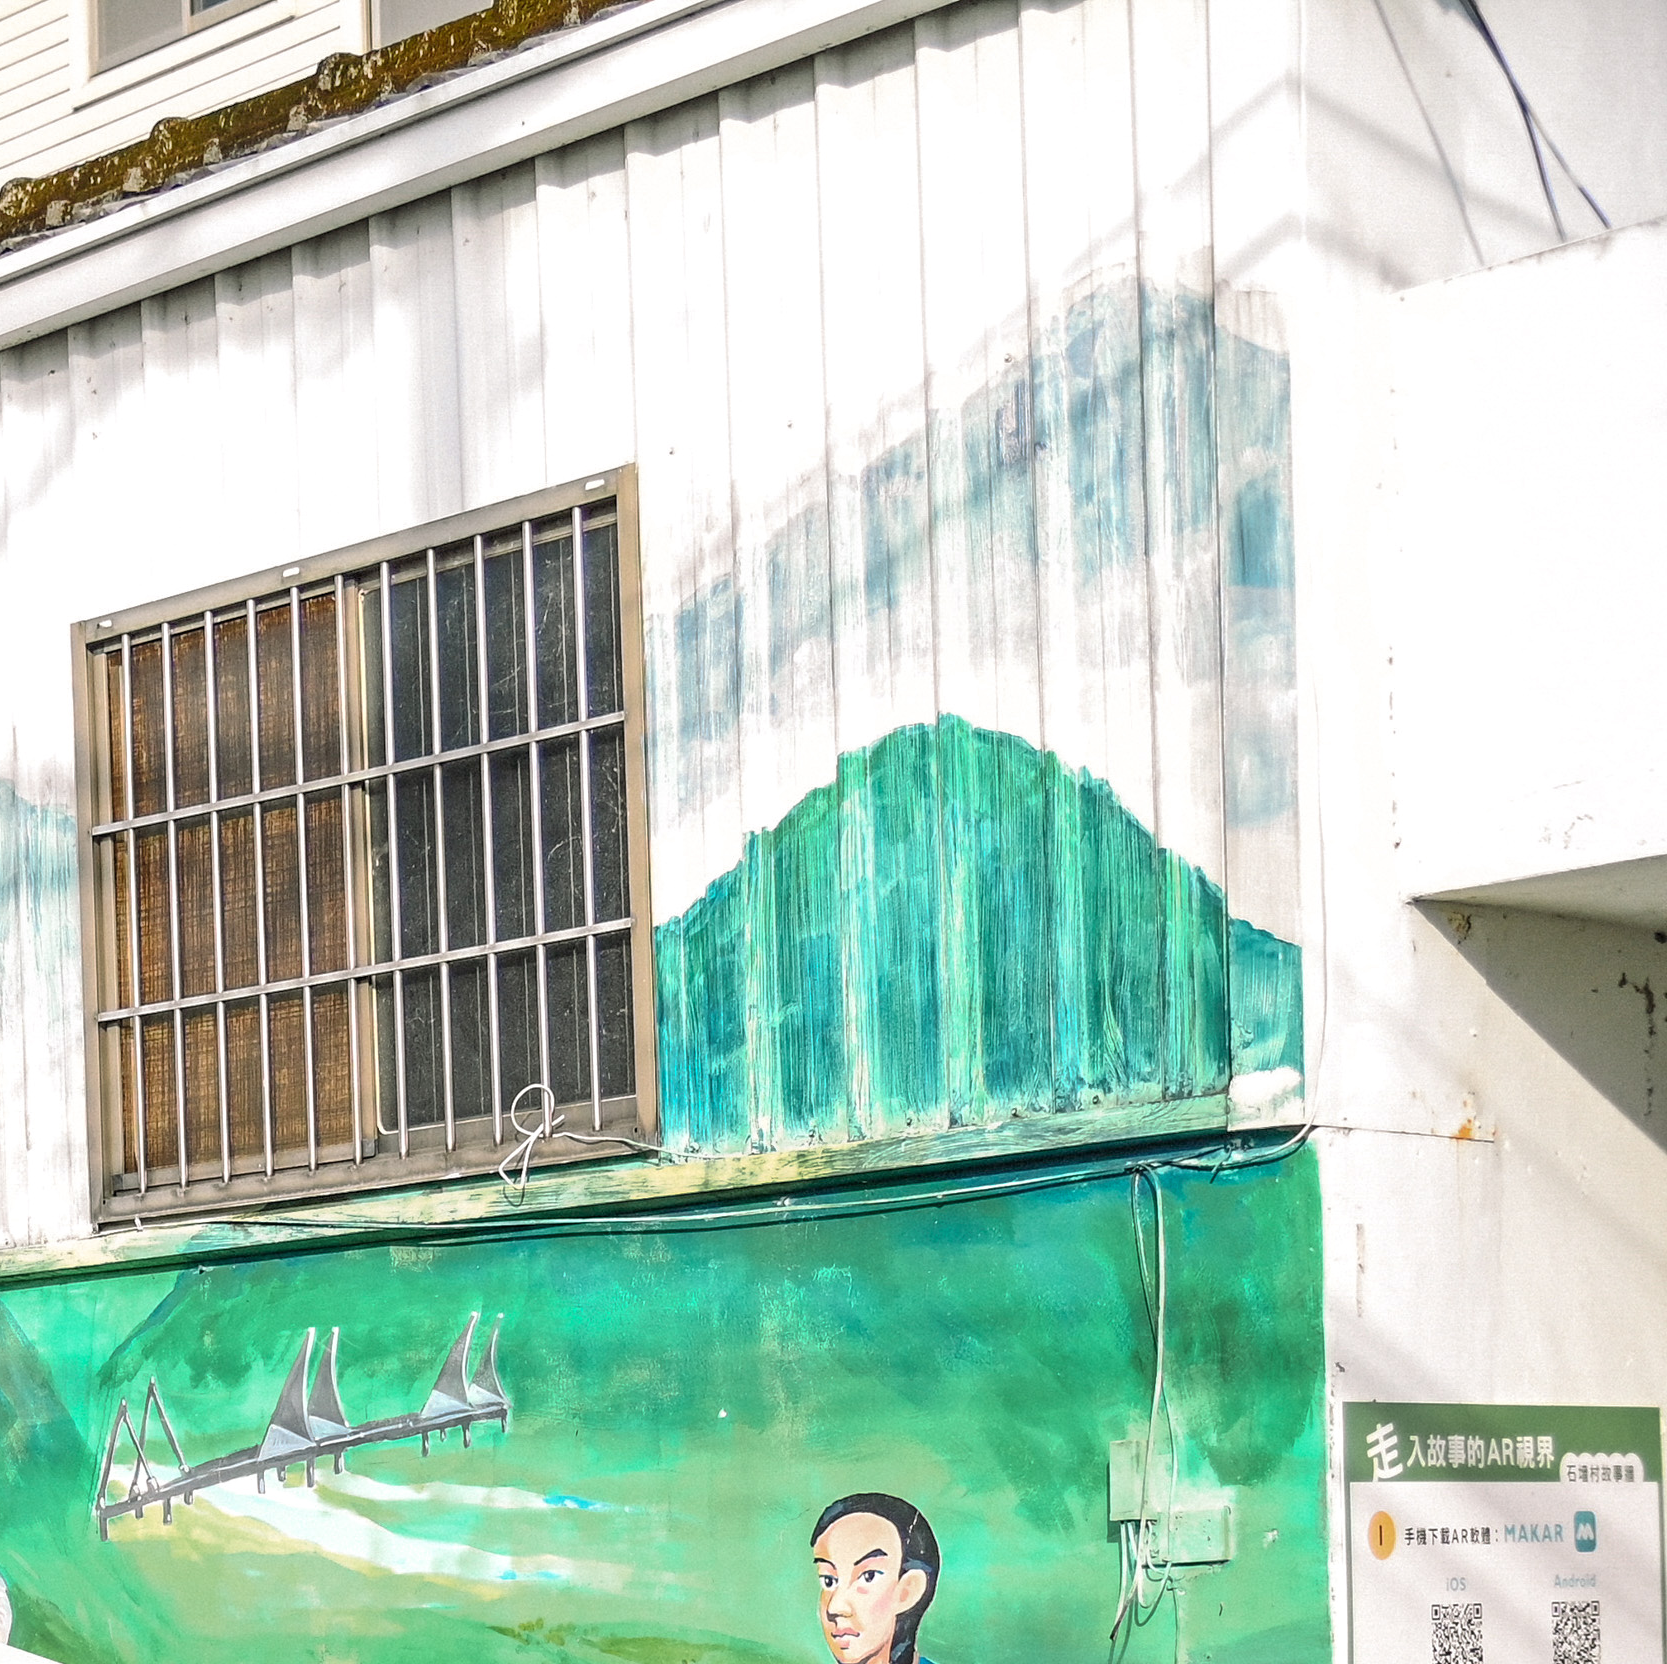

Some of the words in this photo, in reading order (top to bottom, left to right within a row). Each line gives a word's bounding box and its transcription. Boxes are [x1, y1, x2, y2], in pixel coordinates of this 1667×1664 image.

[1367, 1423, 1555, 1481] 走入故事的AR視界
[1504, 1524, 1564, 1543] MAKAR
[1446, 1577, 1467, 1592] iOS
[1554, 1574, 1597, 1589] Android
